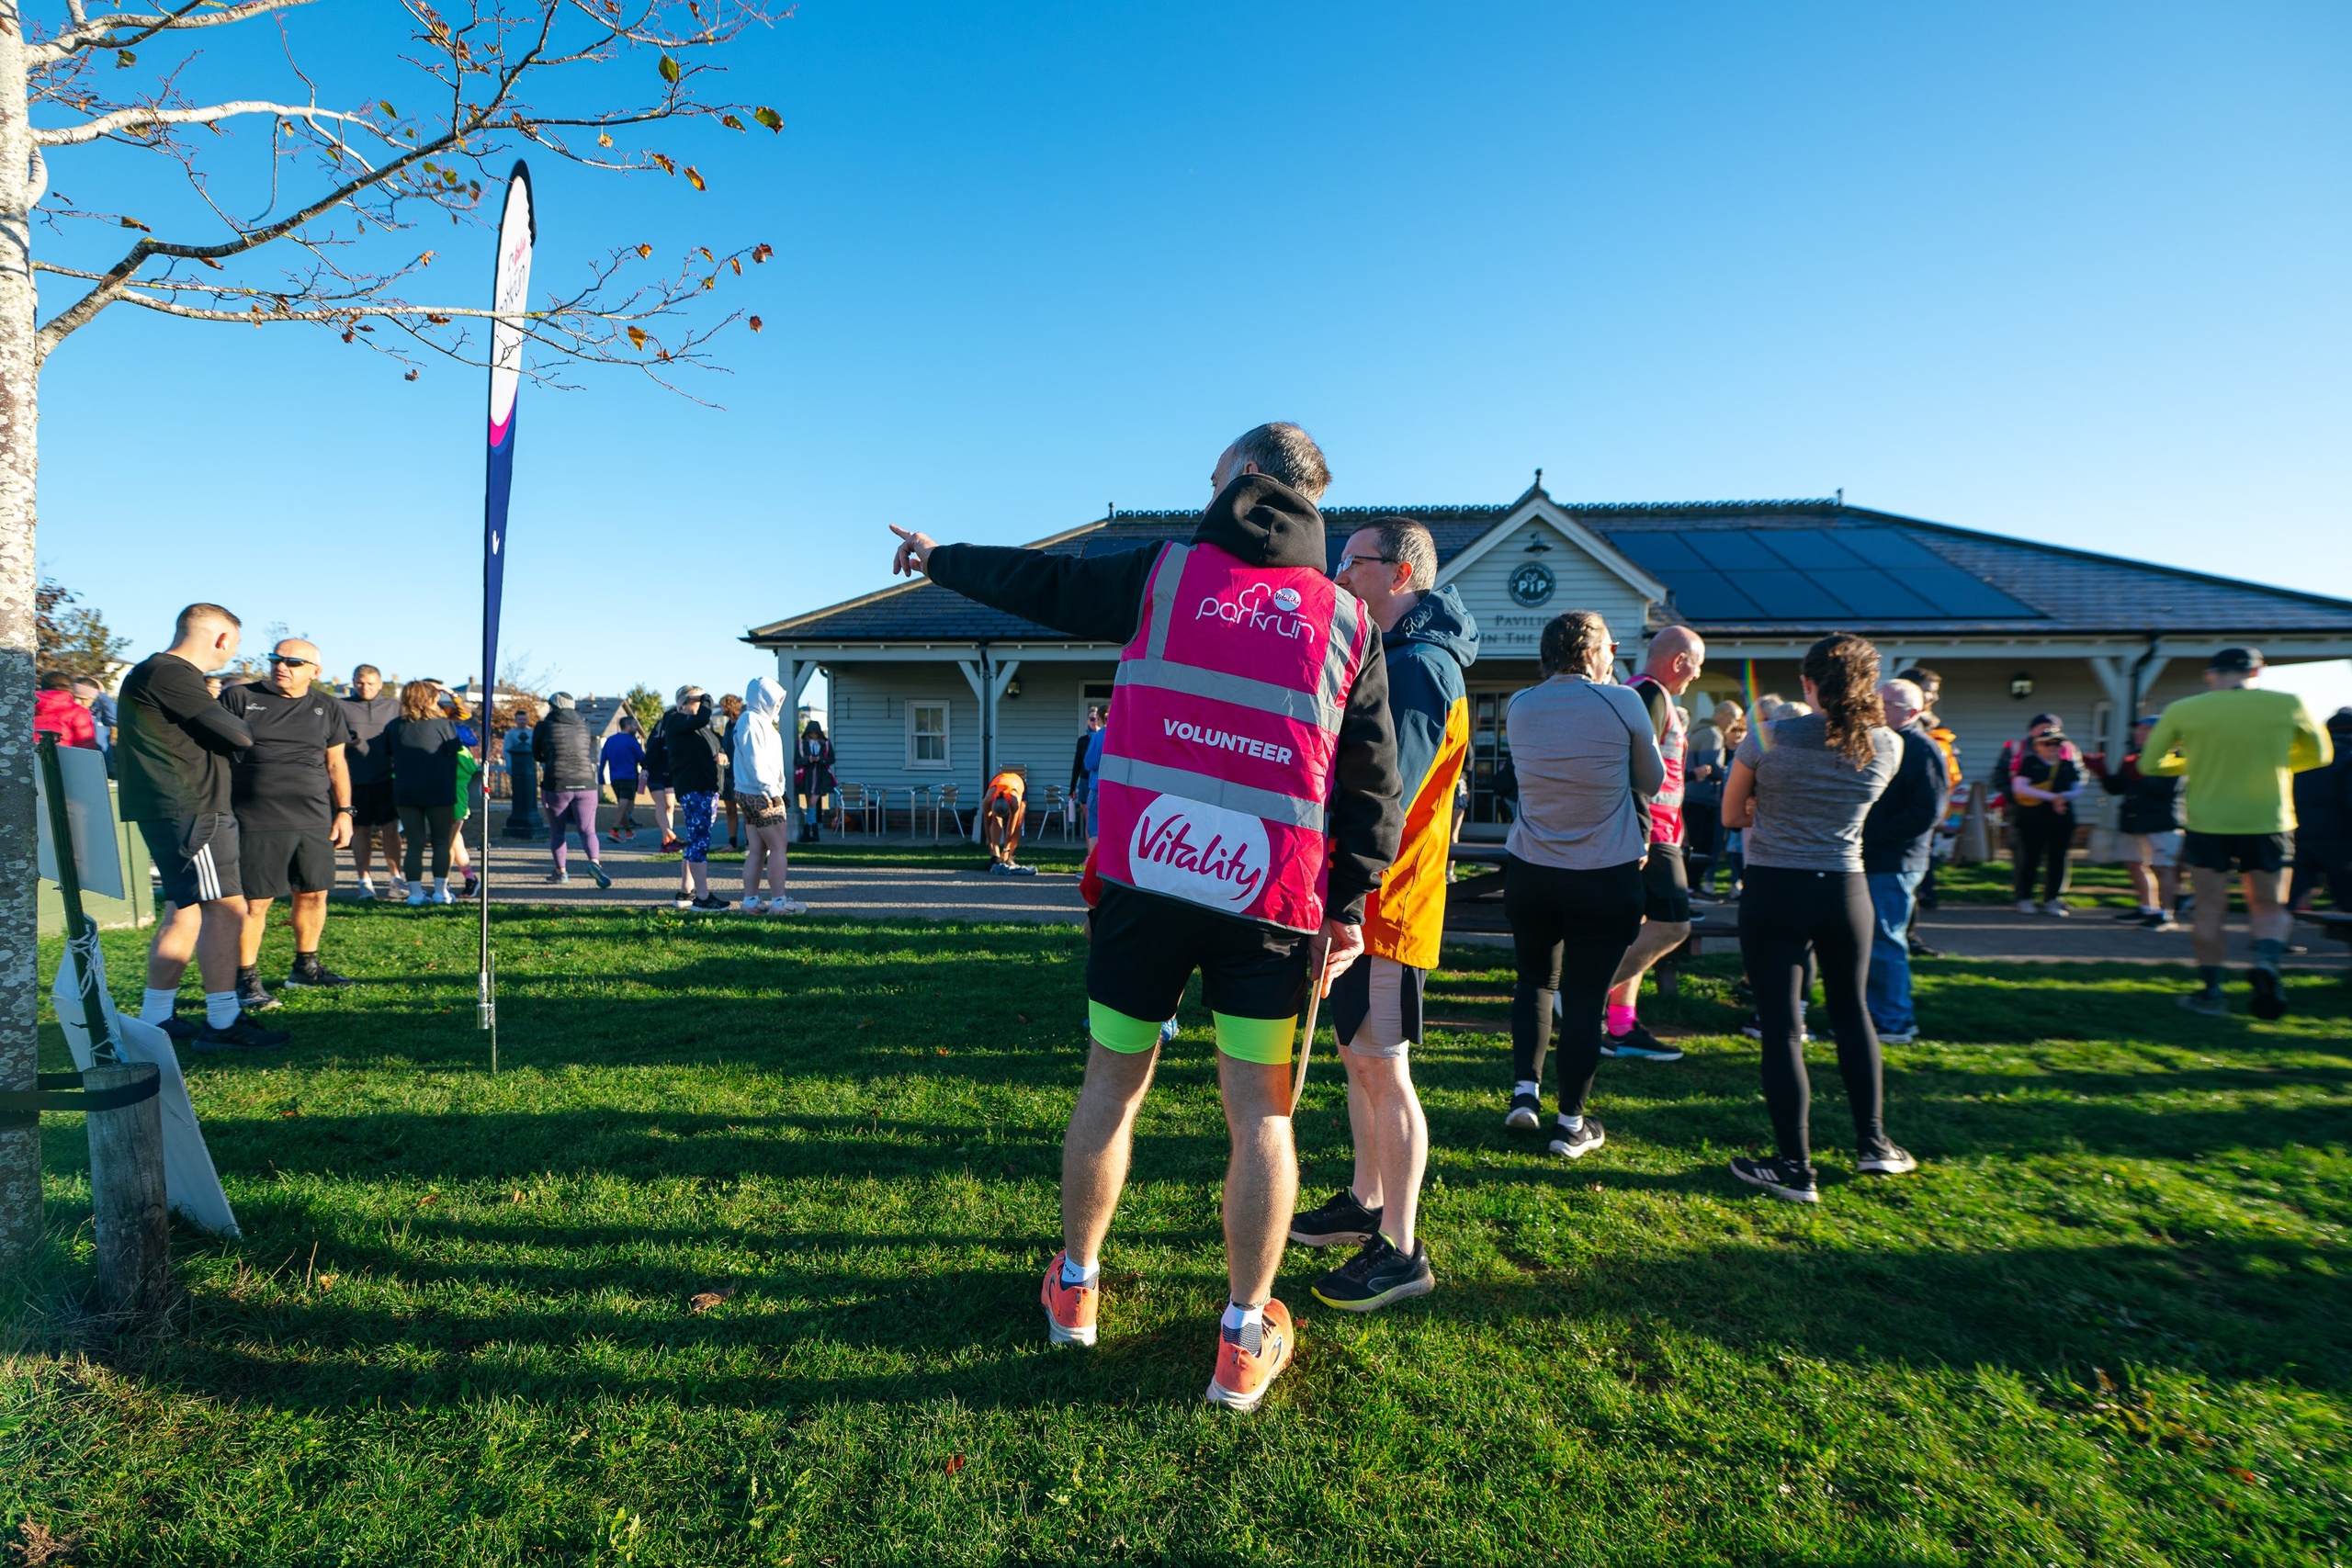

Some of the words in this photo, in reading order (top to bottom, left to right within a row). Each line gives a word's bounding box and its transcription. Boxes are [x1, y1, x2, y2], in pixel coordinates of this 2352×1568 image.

[1195, 582, 1315, 643] parkrun
[1274, 592, 1300, 605] Vitality
[1496, 615, 1554, 626] PAVILIO
[1163, 718, 1293, 765] VOLUNTEER
[1137, 814, 1261, 901] Vitality
